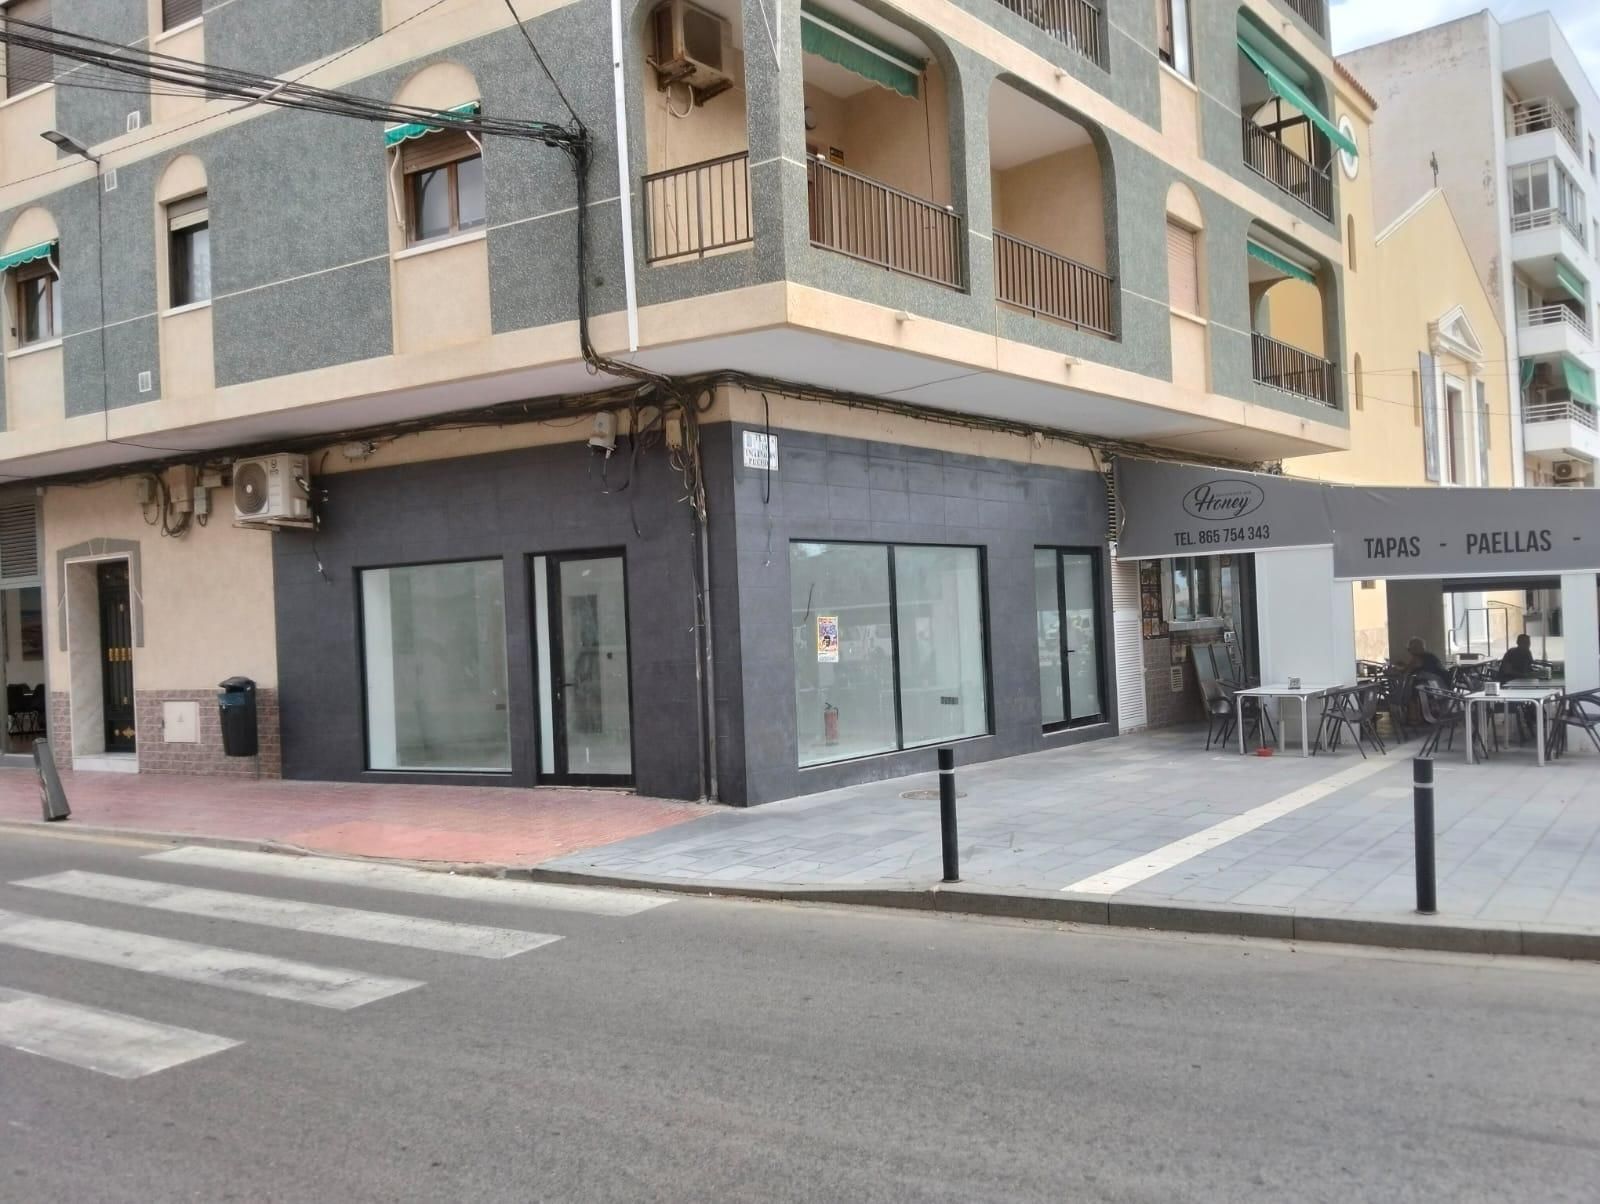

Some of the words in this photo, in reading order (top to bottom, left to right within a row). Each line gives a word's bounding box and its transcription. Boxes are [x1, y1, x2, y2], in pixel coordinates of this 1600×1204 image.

[1194, 485, 1249, 517] Honey
[1173, 531, 1197, 546] TEL.
[1199, 529, 1220, 544] 865
[1223, 527, 1245, 542] 754
[1247, 524, 1270, 540] 343
[1364, 536, 1421, 559] TAPAS
[1466, 529, 1552, 555] PAELLAS
